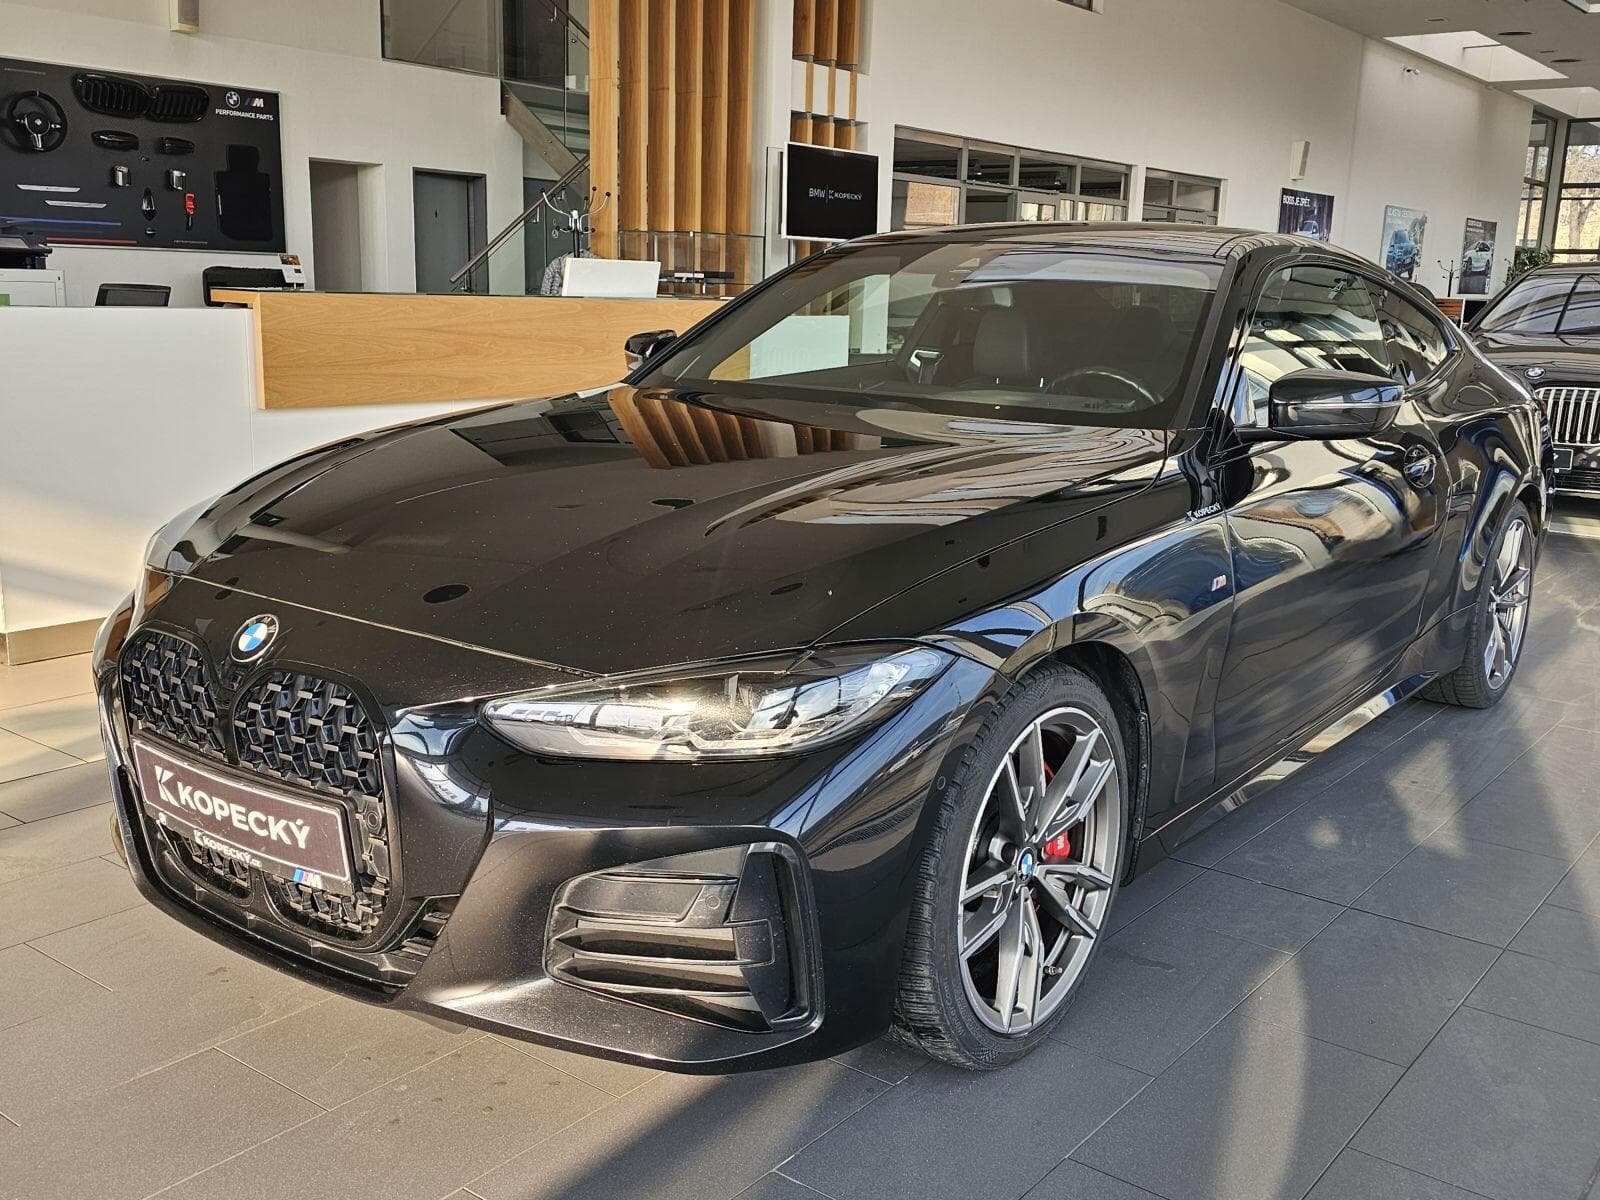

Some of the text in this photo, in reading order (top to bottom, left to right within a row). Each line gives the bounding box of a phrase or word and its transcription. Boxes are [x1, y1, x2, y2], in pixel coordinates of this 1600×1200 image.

[215, 108, 274, 121] PERFORMANCE PARTS
[808, 187, 826, 198] BMW
[177, 781, 310, 849] KOPECKÝ
